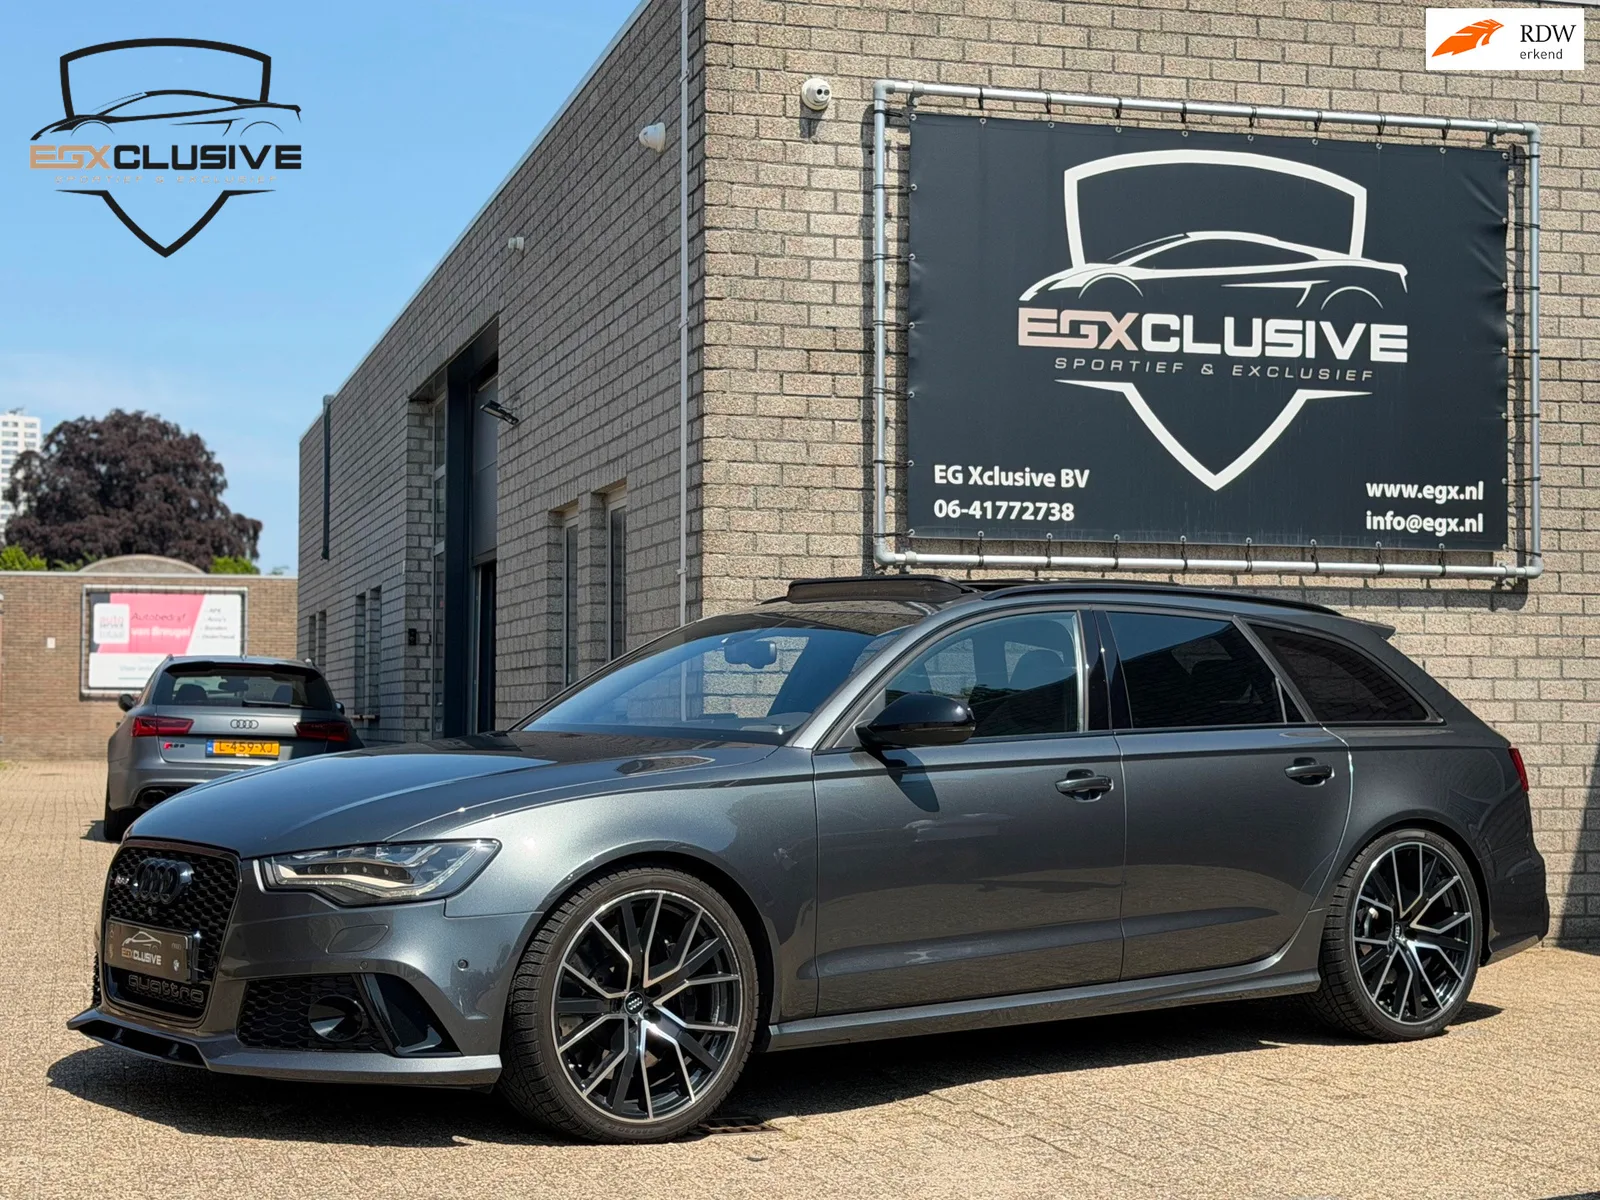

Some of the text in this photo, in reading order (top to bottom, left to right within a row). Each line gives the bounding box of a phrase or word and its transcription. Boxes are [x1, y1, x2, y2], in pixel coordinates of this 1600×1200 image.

[1018, 307, 1409, 363] EGXCLUSIVE
[1054, 357, 1374, 383] SPORTIEF & EXCLUSIEF
[934, 464, 1091, 489] EG Xclusive BV
[1365, 480, 1485, 505] www.egx.nl
[933, 499, 1075, 522] 06-41772738
[1365, 510, 1484, 538] info@egx.nl
[218, 740, 274, 754] L-459-XJ
[128, 973, 205, 1004] quattro
